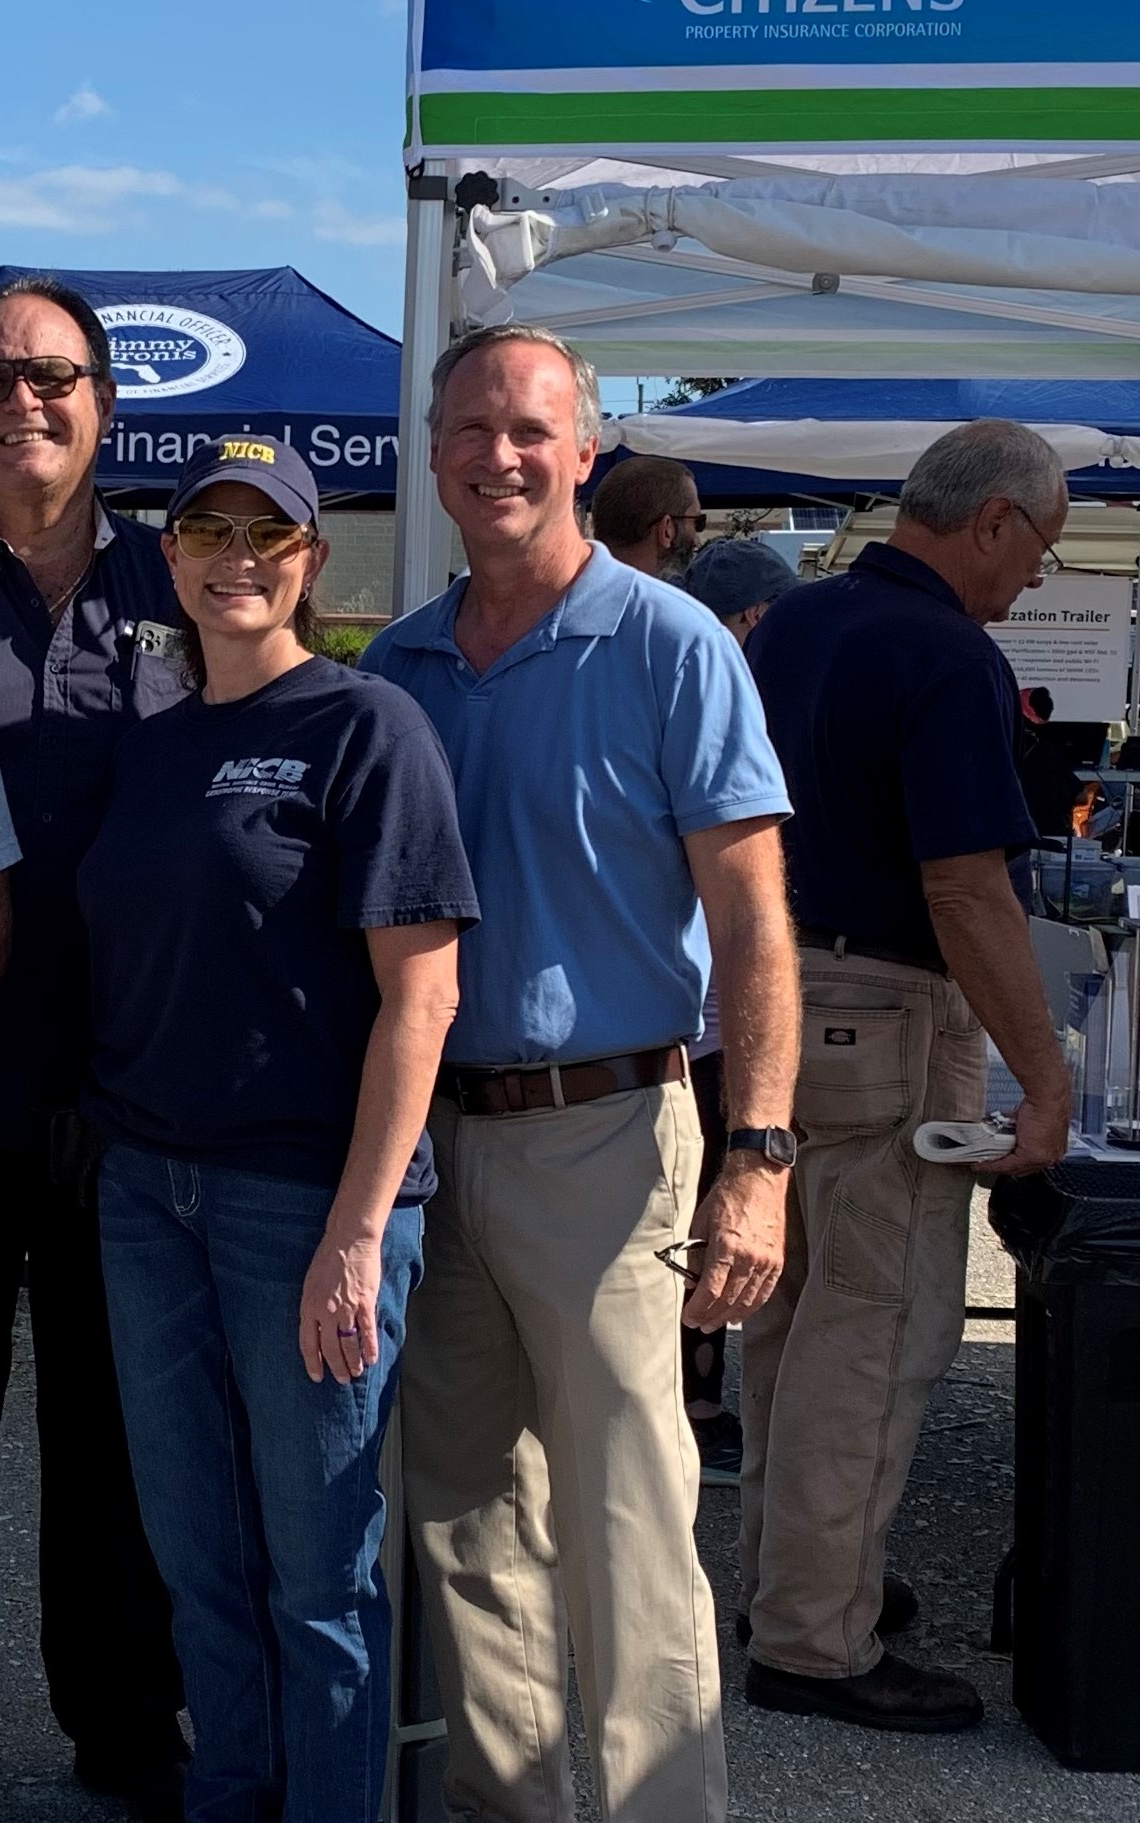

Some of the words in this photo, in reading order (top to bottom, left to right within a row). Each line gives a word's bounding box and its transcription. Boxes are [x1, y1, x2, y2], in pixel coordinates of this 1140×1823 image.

[685, 25, 759, 39] PROPERTY
[763, 24, 850, 38] INSURANCE
[854, 22, 962, 37] CORPORATION
[179, 317, 231, 346] OFFICER
[219, 441, 275, 465] NICB
[1010, 609, 1057, 622] zation
[1061, 609, 1111, 623] Trailer
[211, 757, 307, 783] NICB
